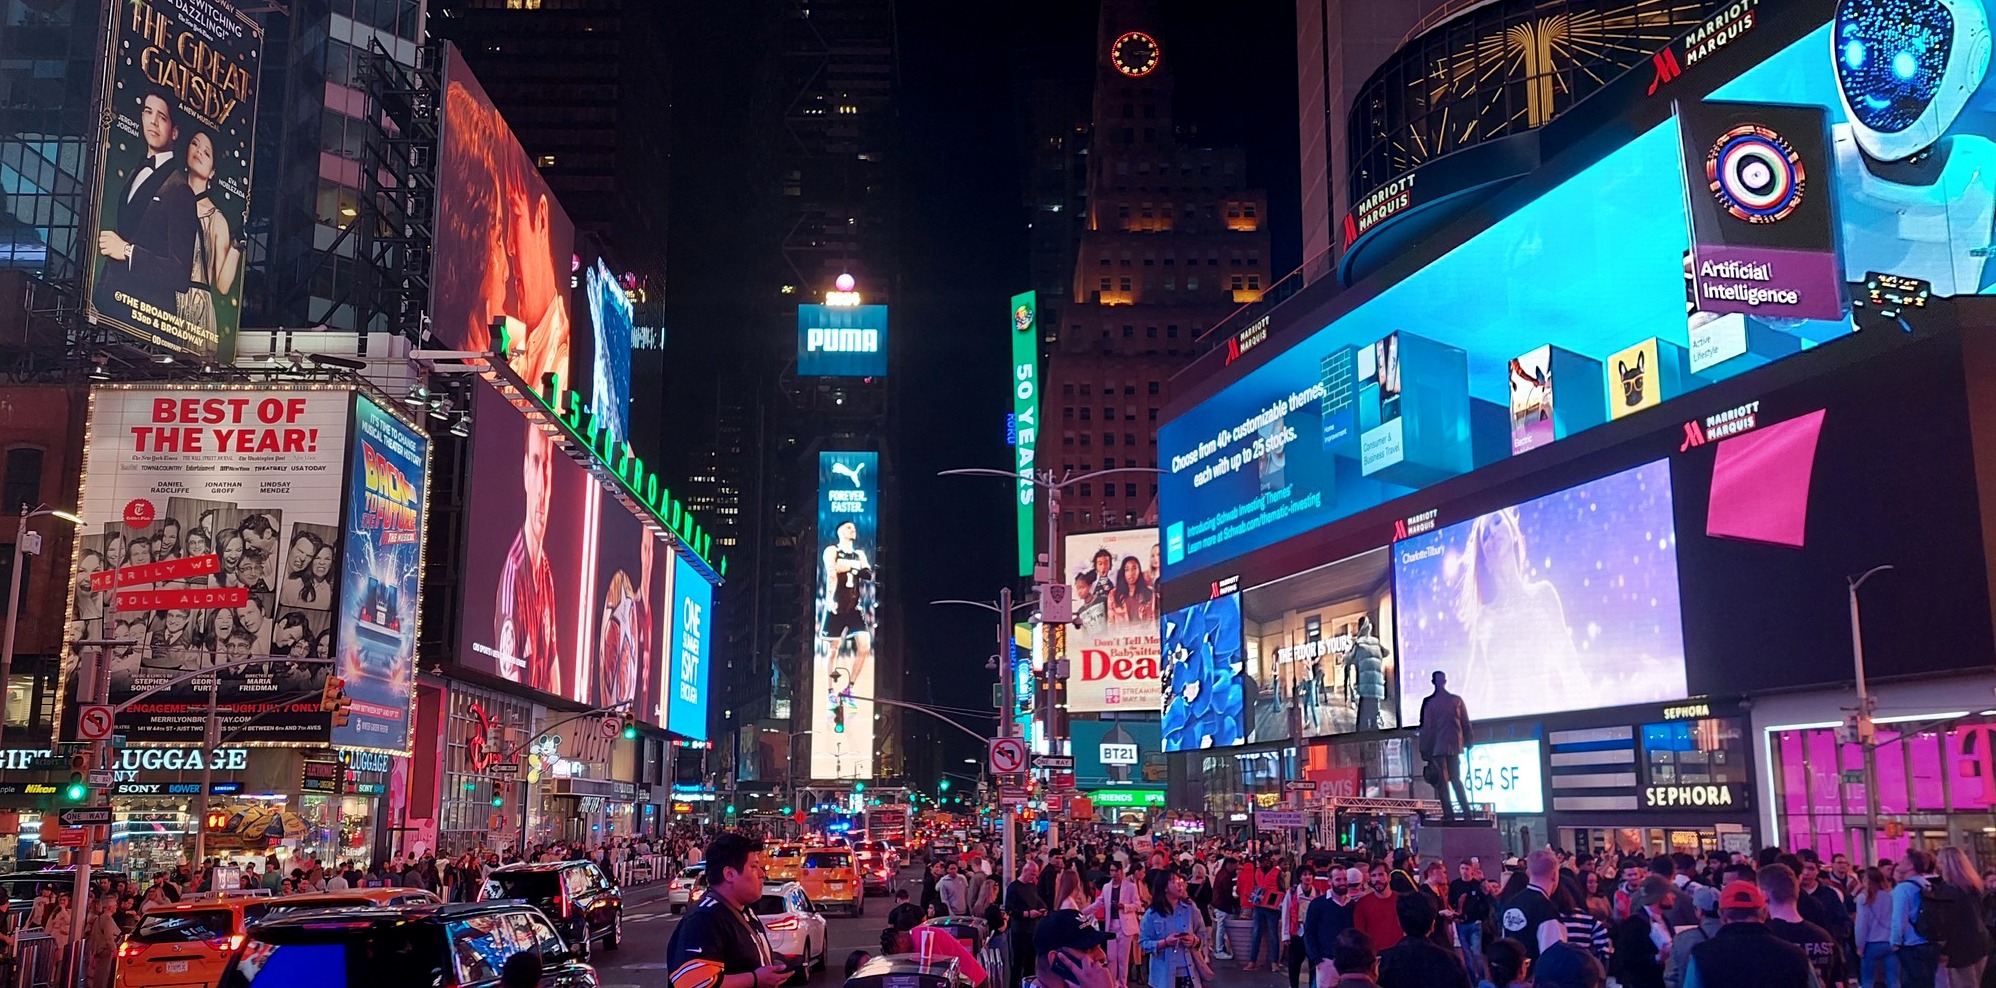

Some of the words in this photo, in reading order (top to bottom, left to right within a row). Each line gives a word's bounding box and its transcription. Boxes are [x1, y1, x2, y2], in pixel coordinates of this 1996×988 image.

[1687, 15, 1753, 65] MARQUIS
[177, 31, 251, 104] GREAT
[141, 46, 237, 125] GATSBY
[116, 121, 139, 138] JORDAN
[118, 113, 140, 129] JEREMY
[183, 106, 197, 117] NEW
[196, 113, 220, 132] MUSICAL
[227, 177, 238, 187] EVA
[1359, 174, 1415, 216] MARRIOTT
[1359, 194, 1408, 231] MARQUIS
[1701, 259, 1771, 281] Artificial
[1702, 282, 1799, 305] Intelligence
[131, 309, 152, 325] 53RD
[152, 318, 160, 329] &
[161, 322, 204, 347] BROADWAY
[140, 302, 184, 328] BROADWAY
[186, 321, 219, 344] THEATRE
[1240, 315, 1270, 342] MARRIOTT
[807, 328, 878, 352] PUMA
[1240, 329, 1267, 354] MARQUIS
[1692, 336, 1711, 348] Active
[1016, 363, 1033, 399] 50
[151, 398, 249, 424] BEST
[257, 398, 306, 424] OF
[1706, 400, 1760, 427] MARRIOTT
[380, 419, 391, 432] TIME
[391, 427, 398, 437] TO
[397, 431, 417, 452] CHANGE
[1171, 447, 1199, 474] Choose
[1199, 438, 1217, 459] from
[1217, 430, 1232, 449] 40+
[1232, 399, 1288, 442] customizable
[1288, 381, 1327, 413] themes,
[1707, 416, 1755, 441] MARQUIS
[131, 427, 203, 453] THE
[212, 427, 318, 453] YEAR!
[361, 420, 383, 444] MUSICAL
[383, 434, 404, 456] THEATER
[403, 446, 422, 467] HISTORY
[1363, 437, 1386, 452] Consumer
[1387, 432, 1392, 442] &
[1514, 434, 1533, 448] Electric
[1018, 405, 1035, 505] YEARS
[1194, 466, 1213, 488] each
[1213, 457, 1230, 478] with
[1230, 454, 1242, 474] up
[1243, 447, 1252, 463] to
[1252, 438, 1265, 459] 25
[1265, 425, 1298, 453] stocks.
[1363, 451, 1385, 466] Business
[1385, 441, 1400, 456] Travel
[362, 439, 417, 505] BACK
[544, 372, 614, 462] 1540
[619, 443, 711, 561] BROADWAY
[365, 492, 378, 513] TO
[828, 490, 867, 502] FOREVER.
[831, 502, 865, 513] FASTER.
[1187, 517, 1216, 538] Introducing
[1216, 506, 1239, 527] Schwab
[1239, 495, 1266, 513] Investing
[1187, 538, 1202, 555] Learn
[1202, 535, 1216, 549] more
[91, 565, 176, 589] MERRILY
[192, 559, 213, 569] WE
[116, 596, 162, 607] ROLL
[180, 593, 238, 604] ALONG
[683, 596, 702, 639] ONE
[1094, 637, 1120, 647] Don't
[1124, 636, 1141, 646] Tell
[1144, 636, 1161, 646] Mo
[1081, 649, 1161, 681] Dea
[291, 703, 320, 713] ONLY
[1663, 704, 1710, 720] SEPHORA
[349, 750, 388, 772] LUGGAGE
[1055, 758, 1070, 766] WAY
[1103, 748, 1134, 760] BT21
[114, 770, 139, 782] NY
[1500, 766, 1519, 791] SF
[25, 784, 57, 794] Nikon
[118, 784, 160, 794] SONY
[169, 784, 201, 793] BOWER
[358, 784, 373, 793] SONY
[1098, 793, 1133, 802] FRIENDS
[1645, 785, 1732, 807] SEPHORA
[89, 812, 106, 820] WAY
[1804, 942, 1834, 955] FAST
